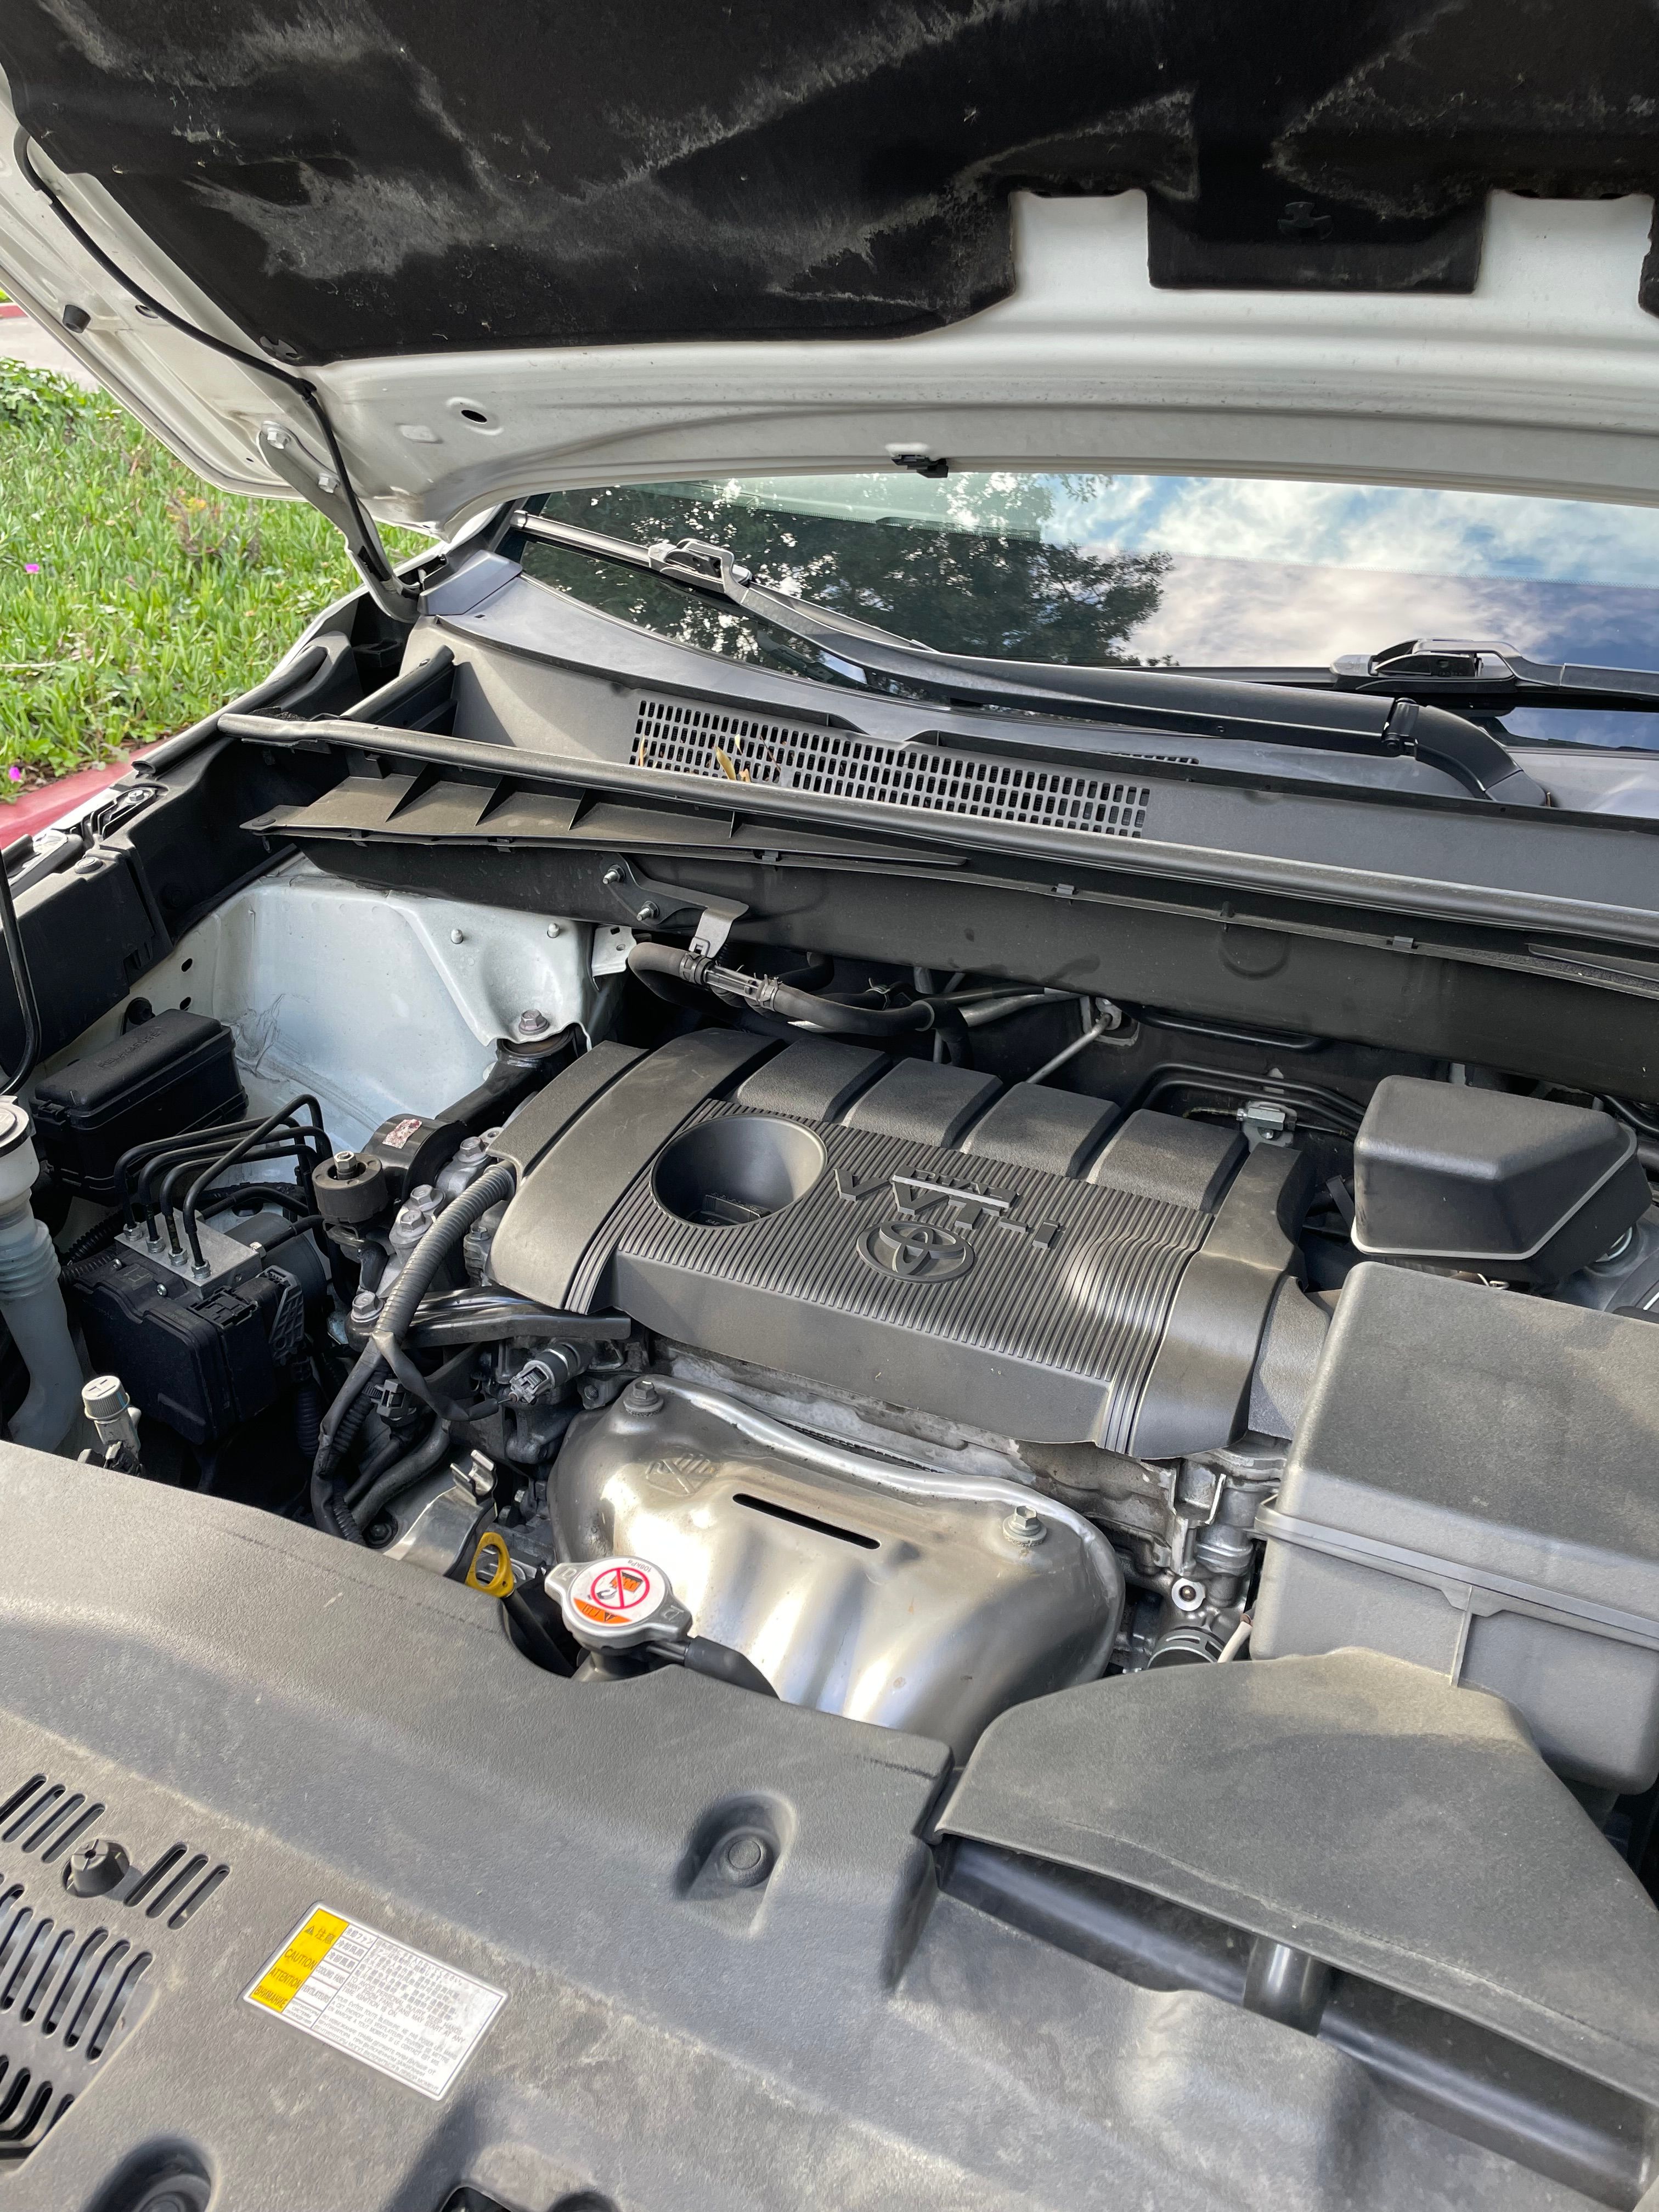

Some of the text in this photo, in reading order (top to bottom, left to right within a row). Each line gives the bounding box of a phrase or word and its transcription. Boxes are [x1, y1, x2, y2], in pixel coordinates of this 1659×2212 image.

[284, 1948, 317, 1970] CAUTION
[269, 1967, 303, 1989] ATTENTION
[253, 1985, 287, 2008] ВНИМАНИЕ
